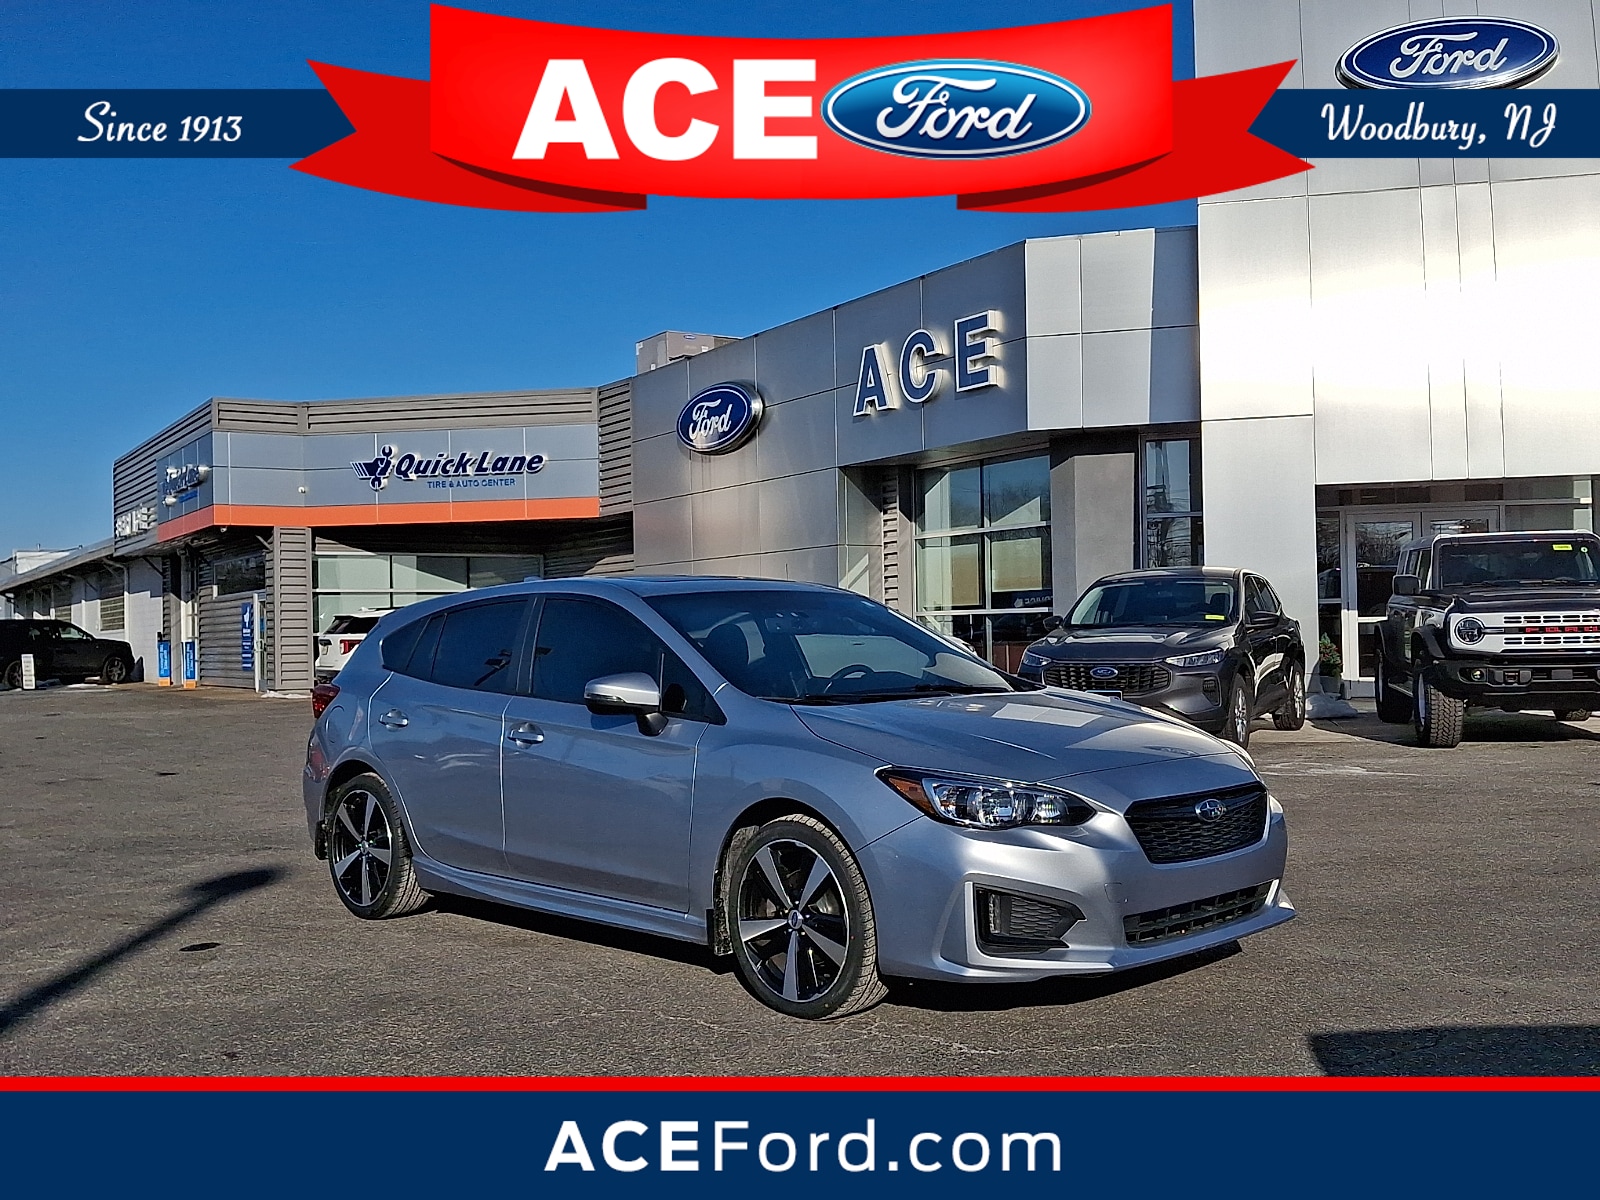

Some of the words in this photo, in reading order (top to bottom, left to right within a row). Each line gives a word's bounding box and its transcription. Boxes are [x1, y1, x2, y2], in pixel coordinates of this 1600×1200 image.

[1389, 31, 1509, 78] Ford
[853, 310, 1000, 416] ACE
[688, 398, 732, 440] Ford
[394, 452, 477, 481] Quick
[473, 451, 549, 475] Lane
[427, 480, 447, 489] TIRE
[456, 479, 480, 488] AUTO
[481, 478, 516, 488] CENTER
